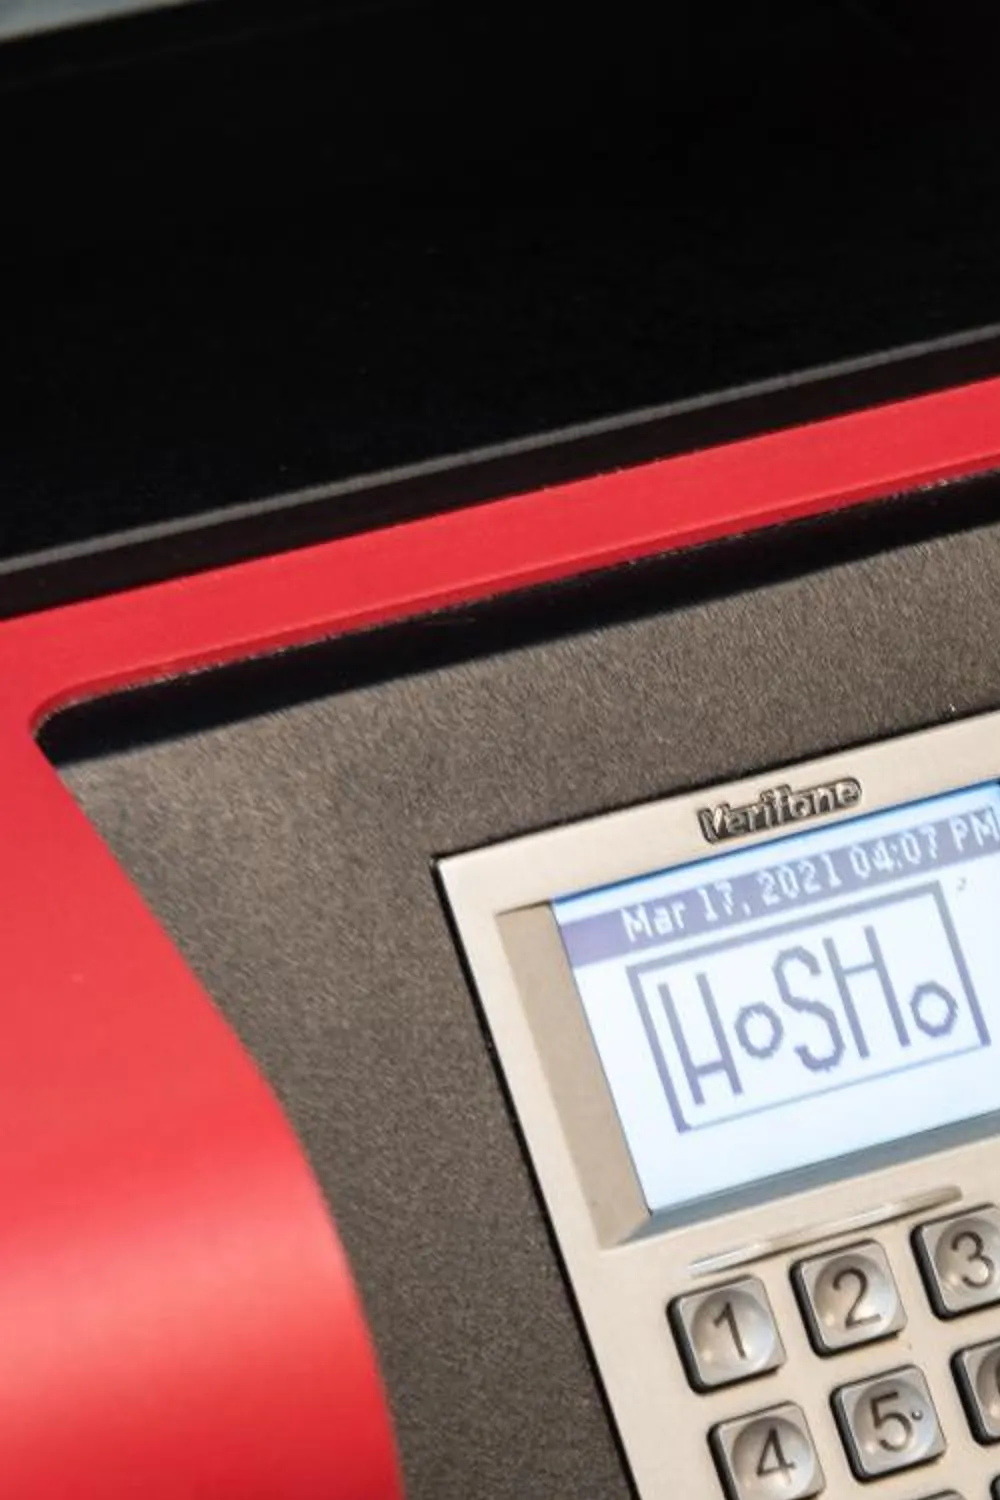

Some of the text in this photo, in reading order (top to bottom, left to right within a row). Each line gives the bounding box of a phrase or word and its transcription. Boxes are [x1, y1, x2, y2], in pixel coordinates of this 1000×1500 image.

[620, 809, 1000, 943] Mar 17, 2021 04:07 PM
[950, 1230, 996, 1289] 3
[831, 1266, 882, 1331] 2
[712, 1302, 749, 1360] 1
[868, 1391, 914, 1452] 5
[755, 1424, 797, 1486] 4
